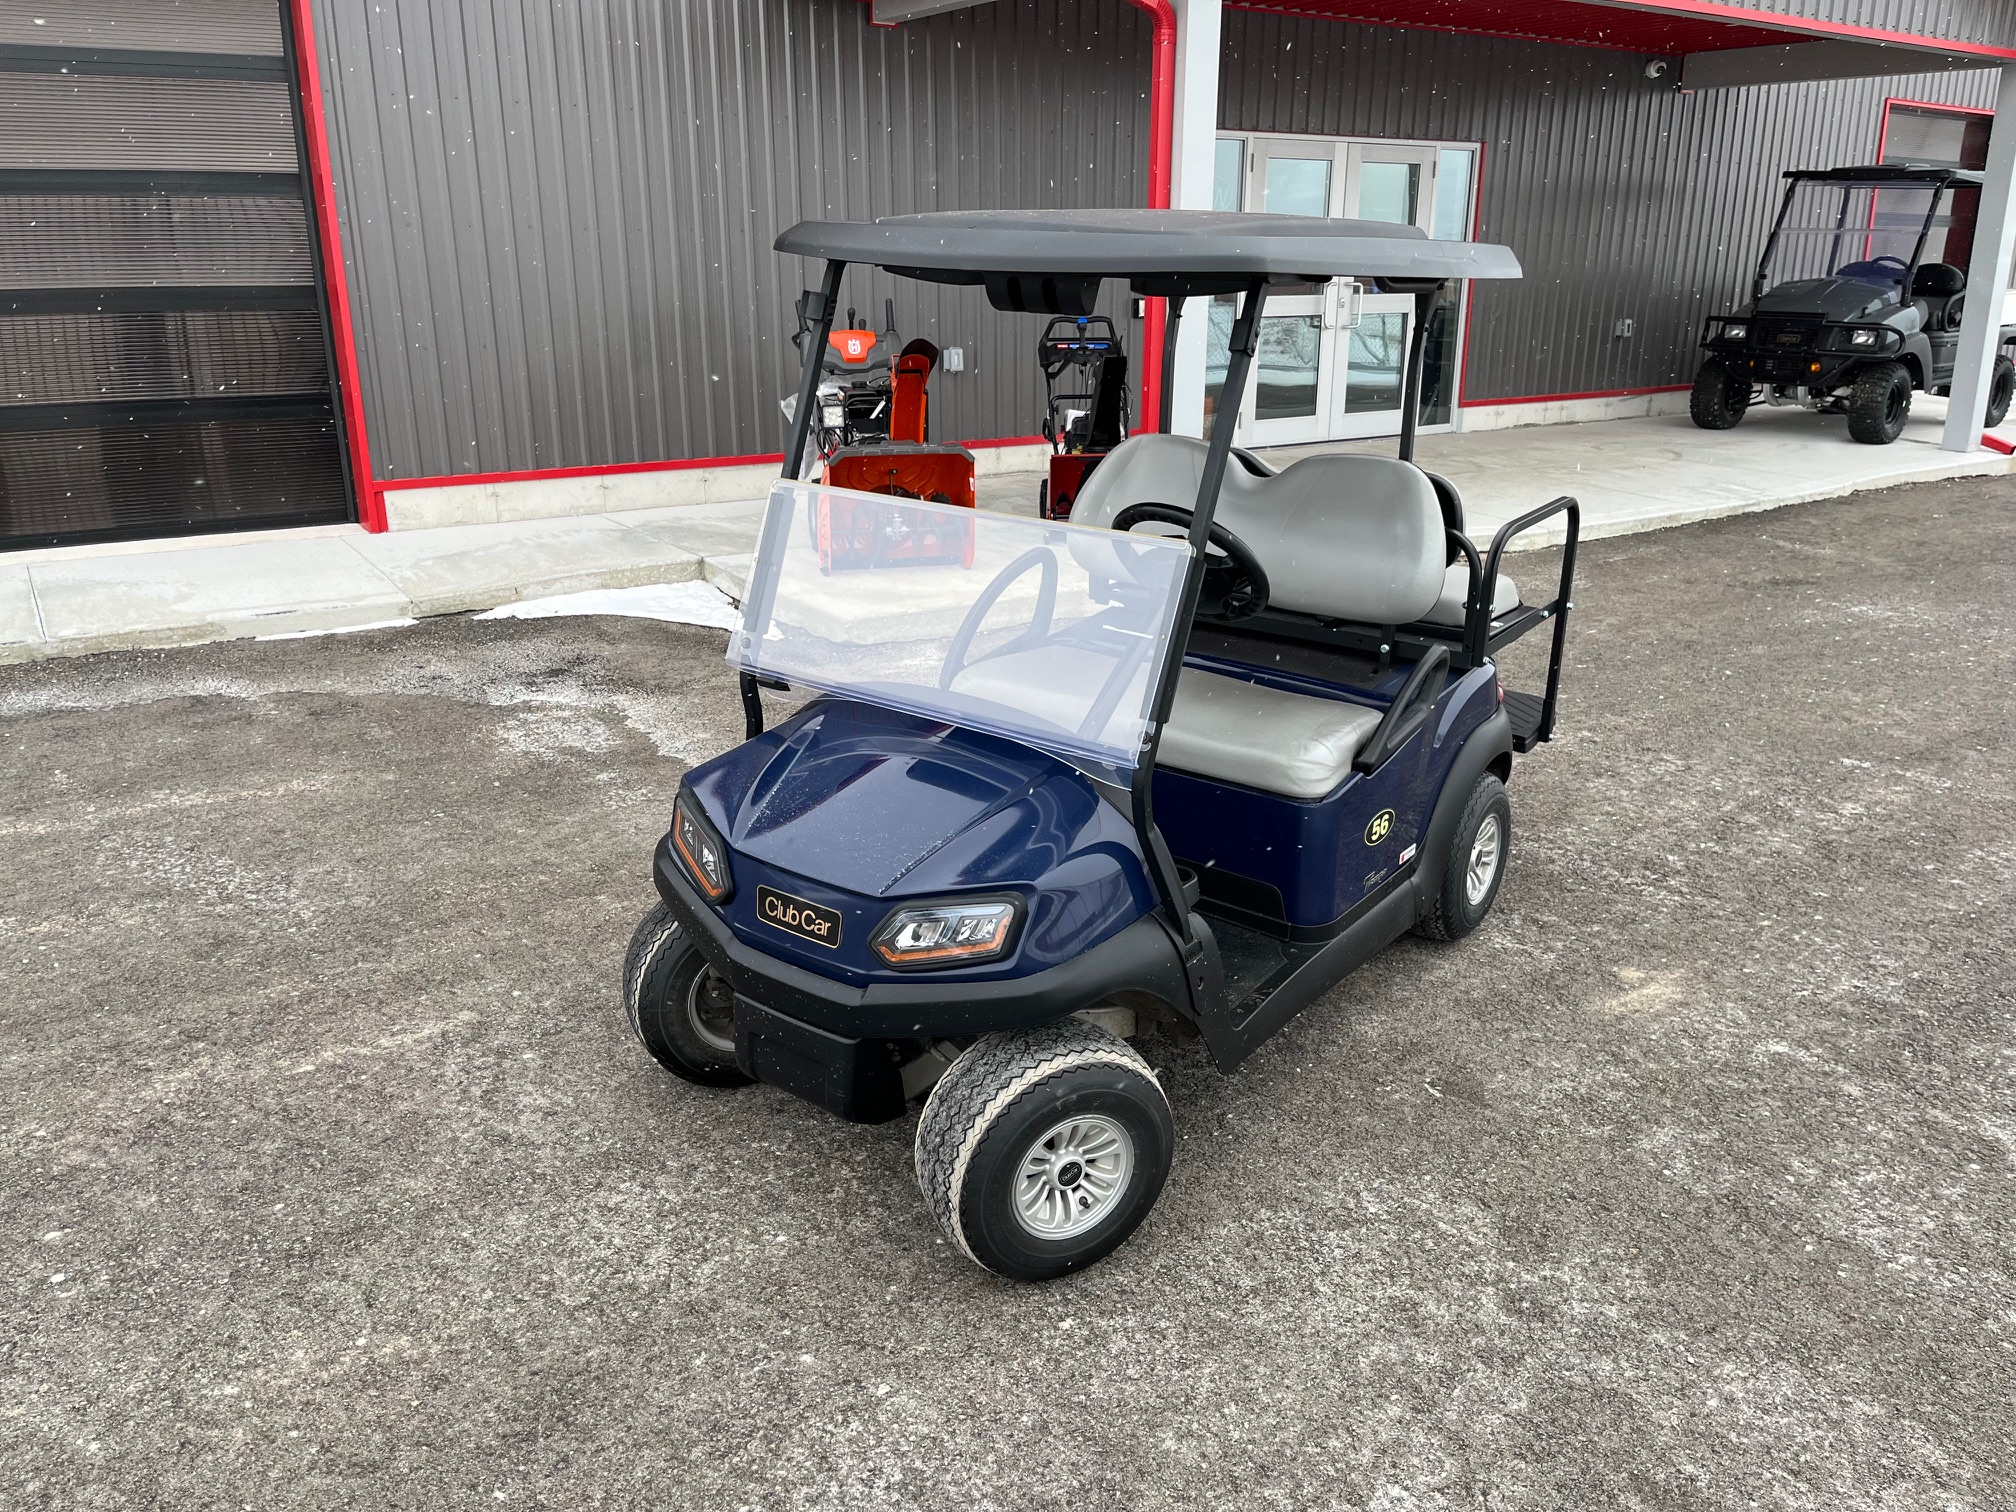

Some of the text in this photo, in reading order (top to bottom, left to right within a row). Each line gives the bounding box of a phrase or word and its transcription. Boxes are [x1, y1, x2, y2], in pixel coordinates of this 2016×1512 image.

[1371, 814, 1389, 841] 56
[765, 896, 832, 937] Club Car
